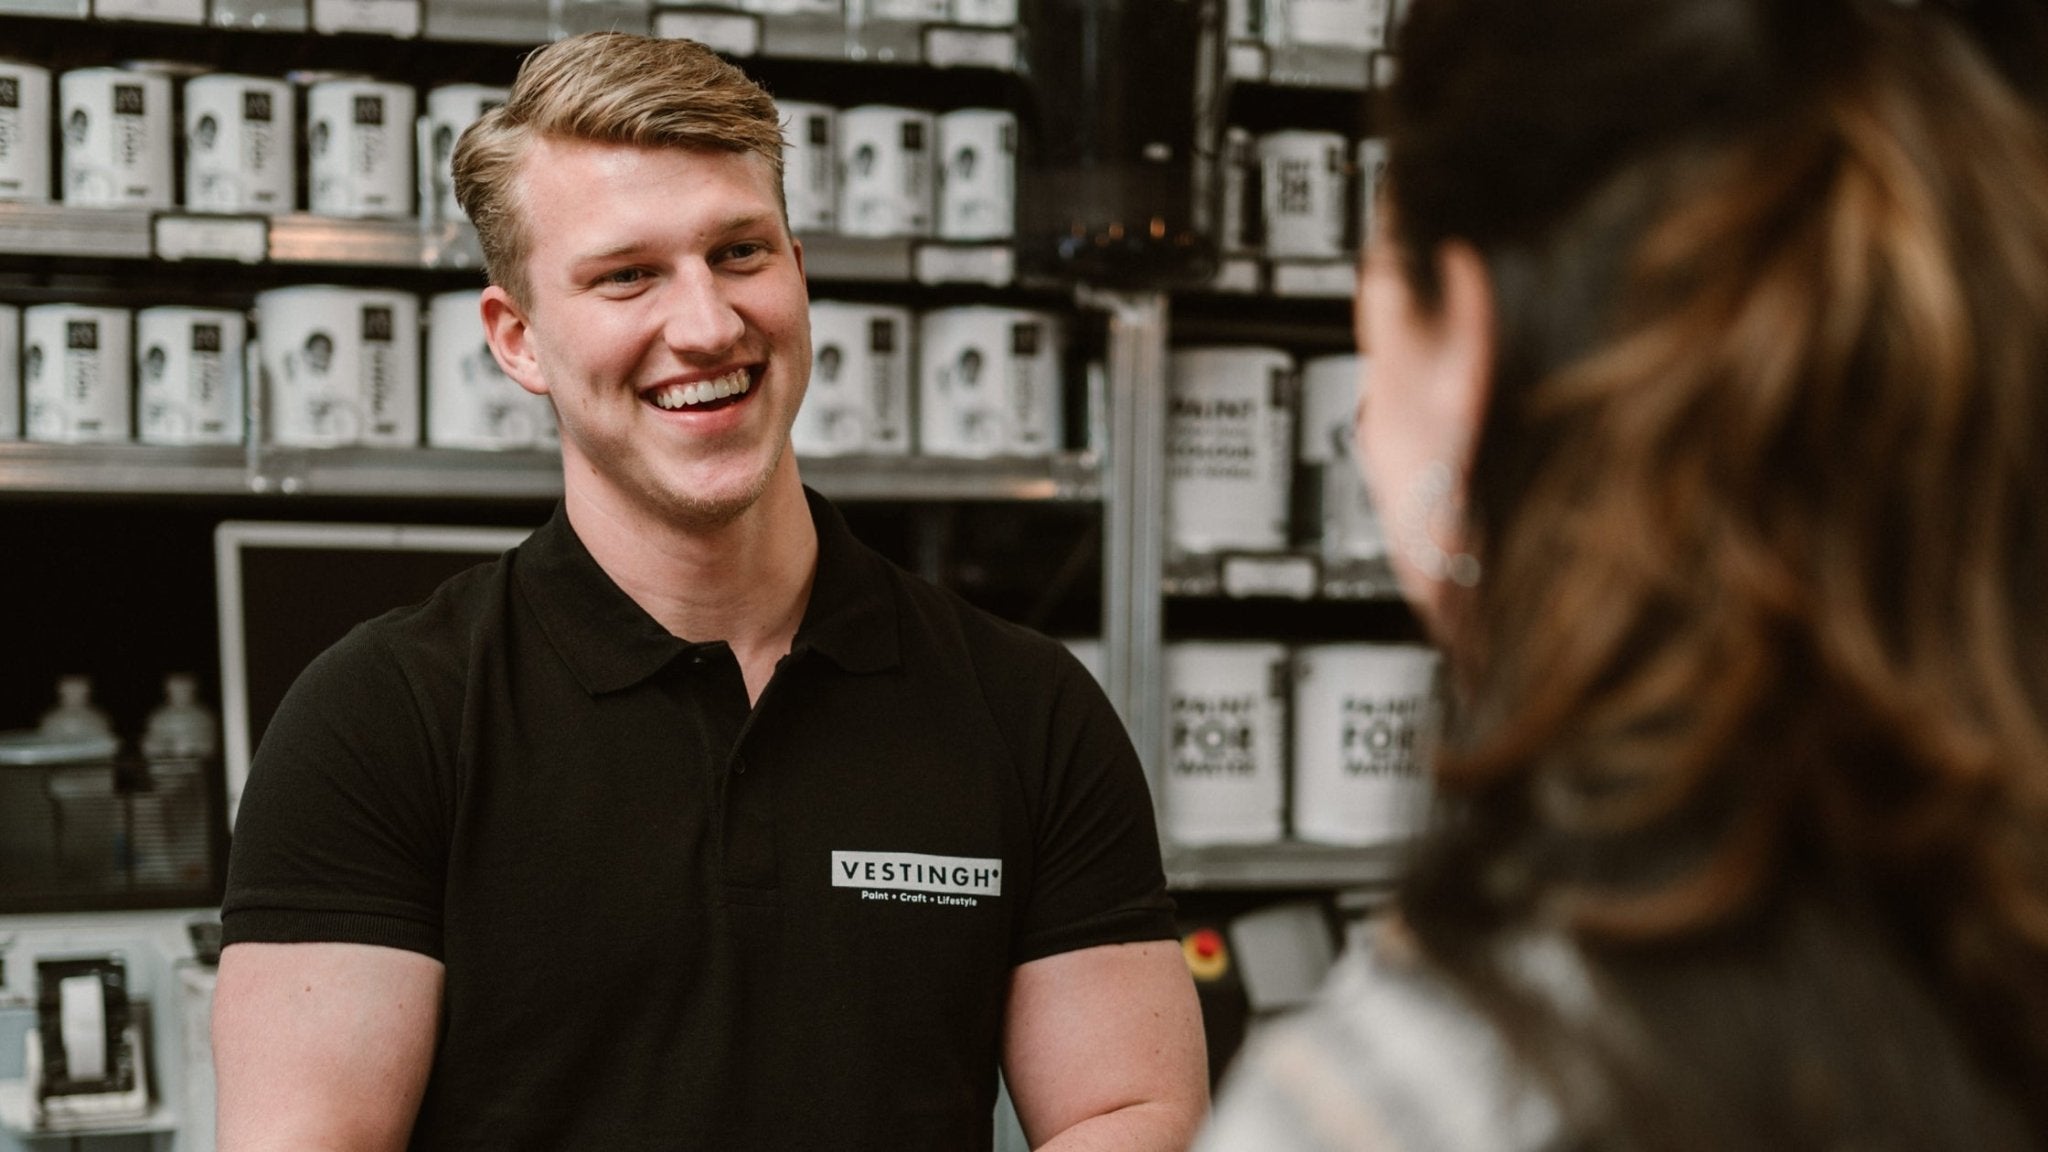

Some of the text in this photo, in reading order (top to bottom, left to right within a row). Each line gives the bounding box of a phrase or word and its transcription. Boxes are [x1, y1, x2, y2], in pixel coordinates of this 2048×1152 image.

[1173, 695, 1256, 717] PAINT
[1173, 721, 1255, 755] FOR
[1343, 722, 1420, 755] FOR
[861, 890, 978, 907] Paint Craft Lifestyle
